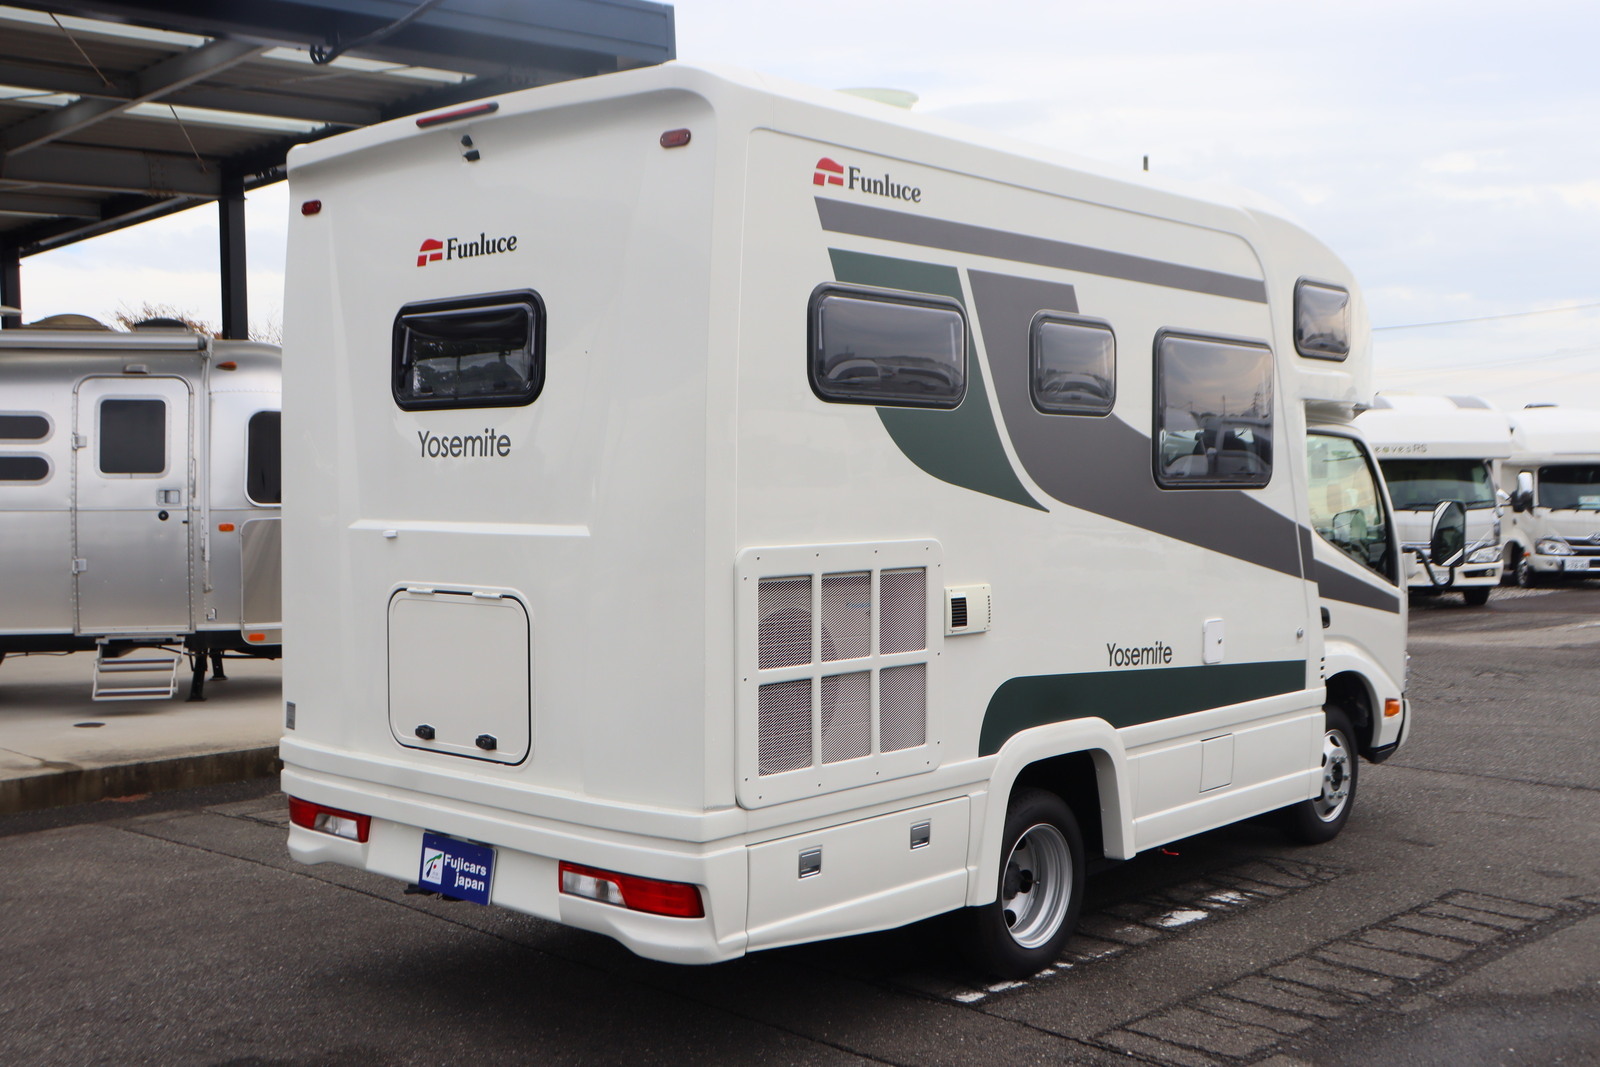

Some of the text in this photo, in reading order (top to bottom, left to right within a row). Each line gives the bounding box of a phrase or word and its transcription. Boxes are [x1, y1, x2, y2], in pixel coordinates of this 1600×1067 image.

[848, 165, 921, 203] Funluce
[446, 232, 517, 260] Funluce
[418, 427, 511, 458] Yosemite
[1106, 640, 1173, 667] Yosemite
[444, 853, 487, 876] Fujicars
